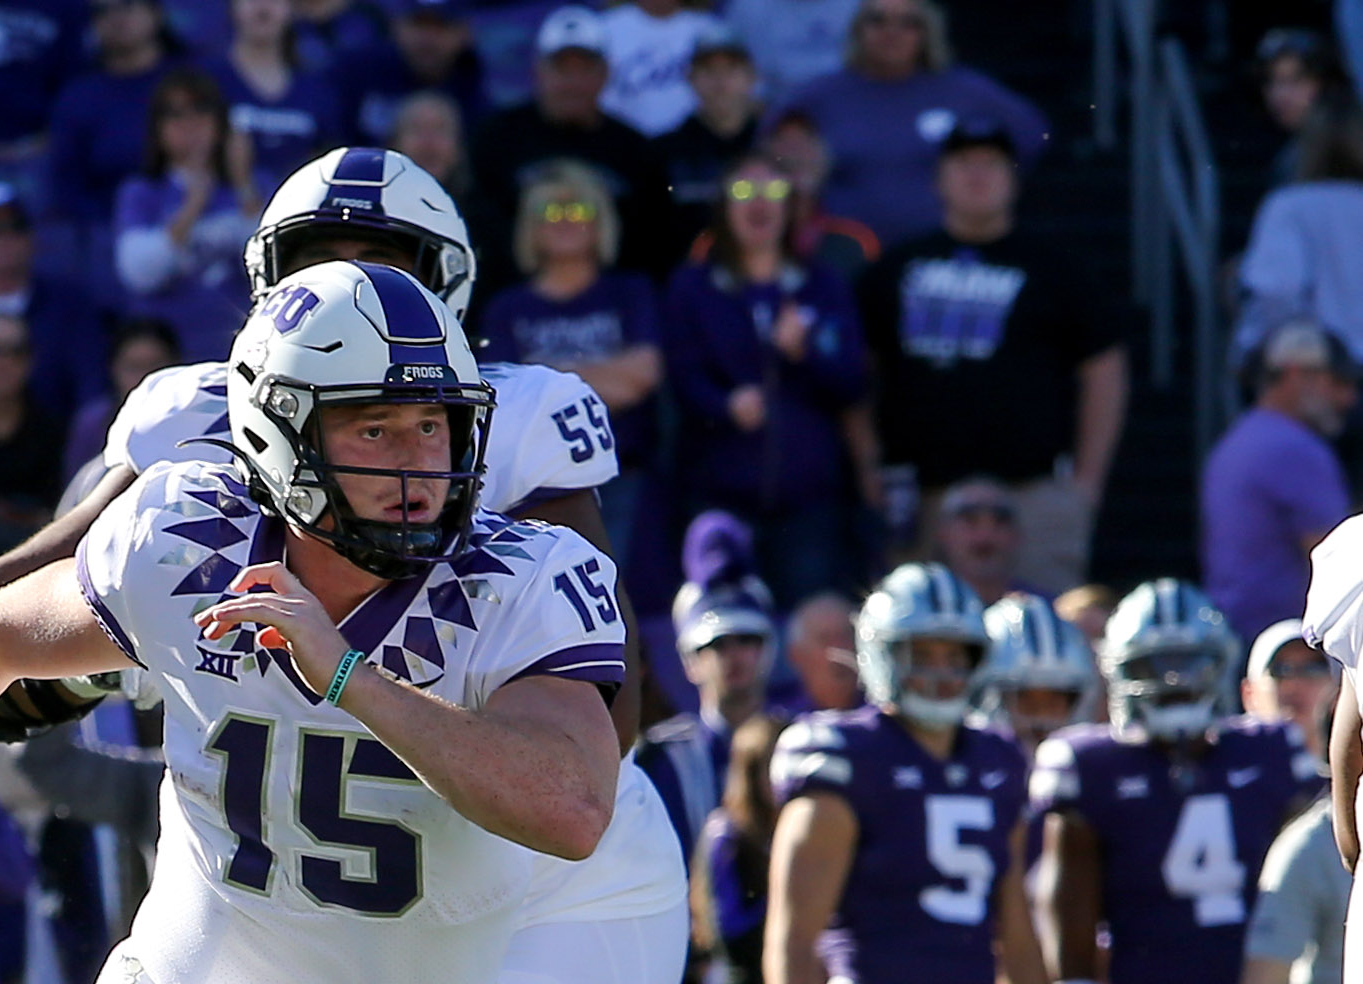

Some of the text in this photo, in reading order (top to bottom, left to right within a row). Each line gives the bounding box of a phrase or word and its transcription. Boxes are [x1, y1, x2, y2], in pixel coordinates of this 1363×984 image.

[403, 366, 444, 380] FROGS
[551, 394, 613, 464] 55
[552, 556, 618, 633] 15
[204, 711, 425, 918] 15
[918, 794, 995, 926] 5
[1161, 793, 1247, 927] 4
